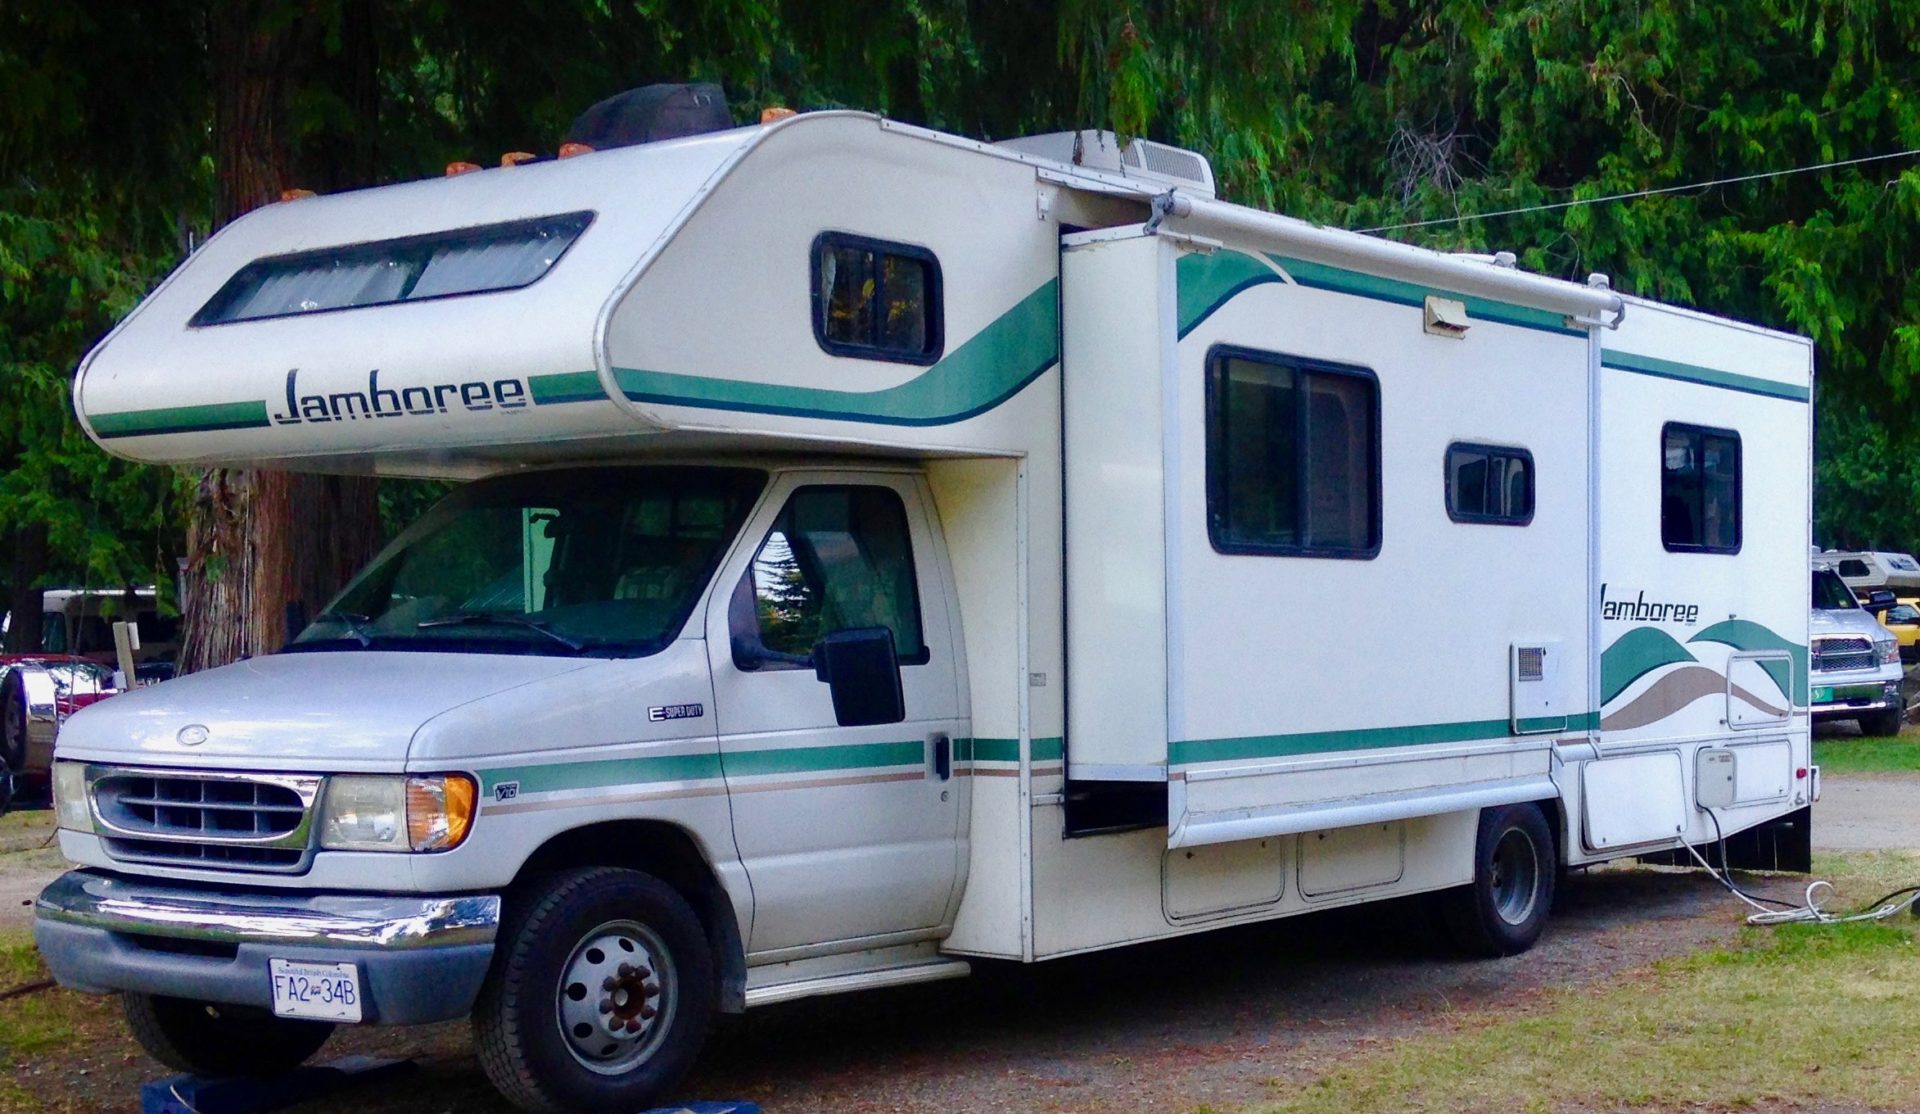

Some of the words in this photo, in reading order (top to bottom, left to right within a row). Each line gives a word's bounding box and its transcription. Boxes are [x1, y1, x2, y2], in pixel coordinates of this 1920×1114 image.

[274, 368, 527, 424] Jamboree
[666, 706, 685, 718] SUPER
[686, 704, 702, 716] DUTY
[274, 975, 311, 1002] FA2
[320, 977, 356, 1005] 34B
